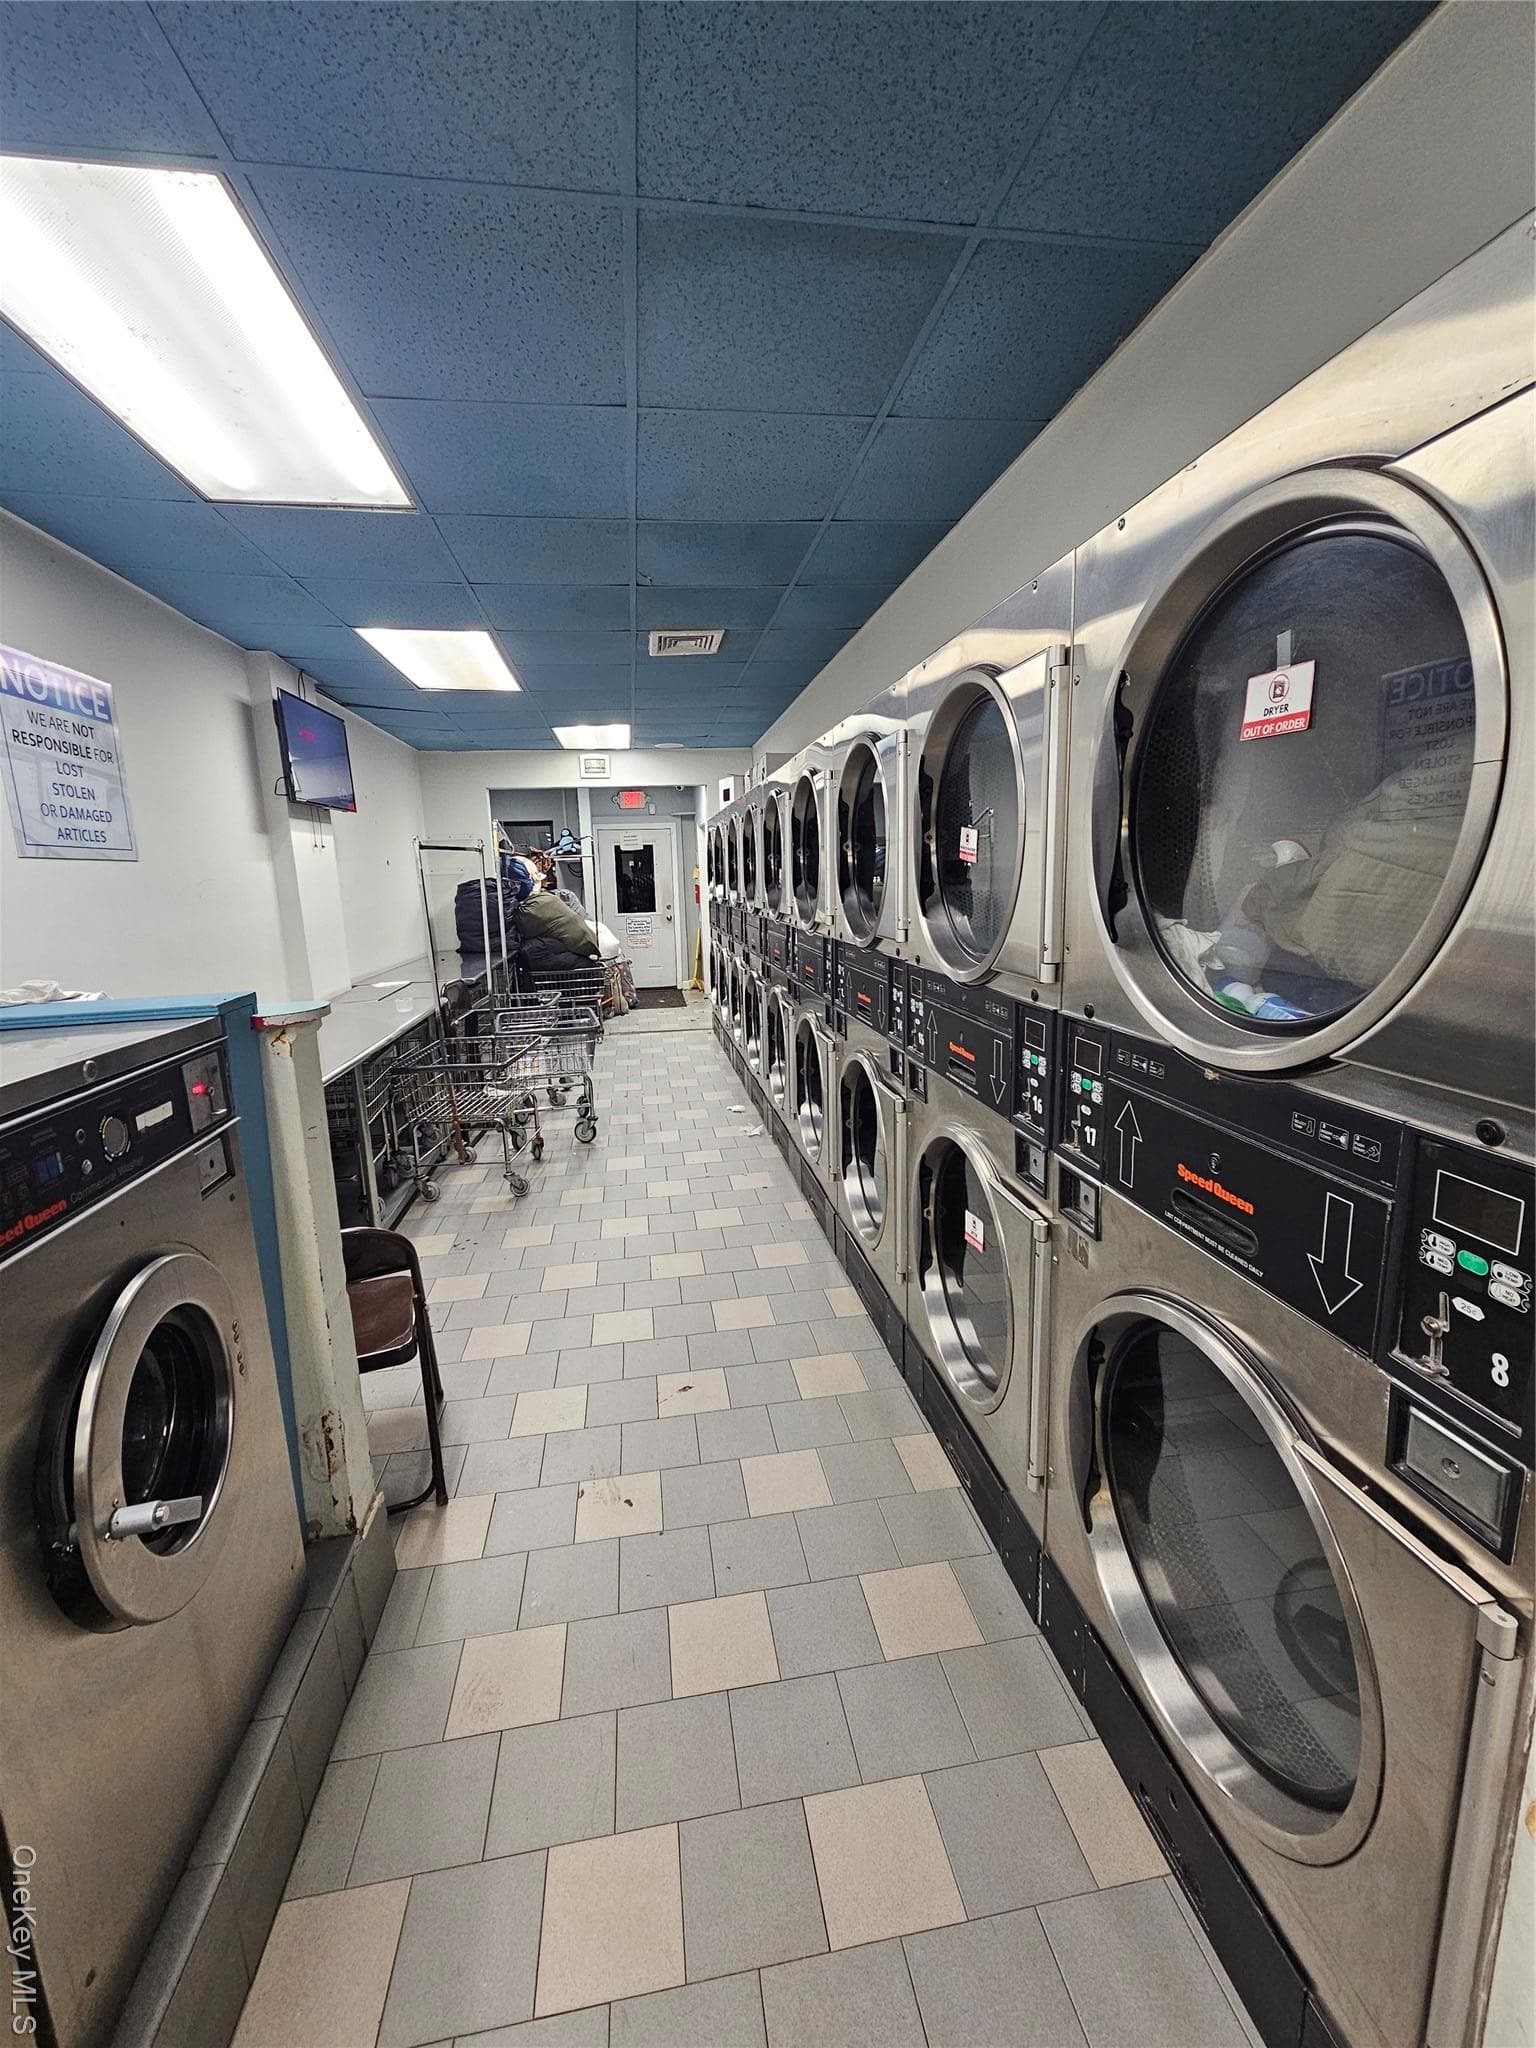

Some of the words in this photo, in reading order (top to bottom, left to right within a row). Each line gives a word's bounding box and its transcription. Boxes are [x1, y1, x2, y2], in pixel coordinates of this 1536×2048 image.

[0, 656, 109, 721] NOTICE
[1263, 703, 1289, 717] DRYER
[27, 709, 47, 728] WE
[48, 716, 71, 734] ARE
[72, 722, 95, 739] NOT
[1243, 726, 1262, 738] OUT
[1262, 723, 1275, 735] OF
[1275, 717, 1306, 731] ORDER
[11, 728, 92, 760] RESPONSIBLE
[93, 748, 114, 764] FOR
[56, 761, 83, 778] LOST
[52, 783, 96, 801] STOLEN
[40, 803, 58, 818] OR
[59, 805, 113, 823] DAMAGED
[57, 827, 107, 843] ARTICLES
[1032, 1095, 1043, 1115] 16
[1084, 1126, 1097, 1146] 17
[1177, 1163, 1214, 1193] Speed
[1214, 1182, 1254, 1216] Queen
[24, 1199, 68, 1230] Queen
[1248, 1264, 1264, 1277] DAILY
[1491, 1353, 1510, 1387] 8
